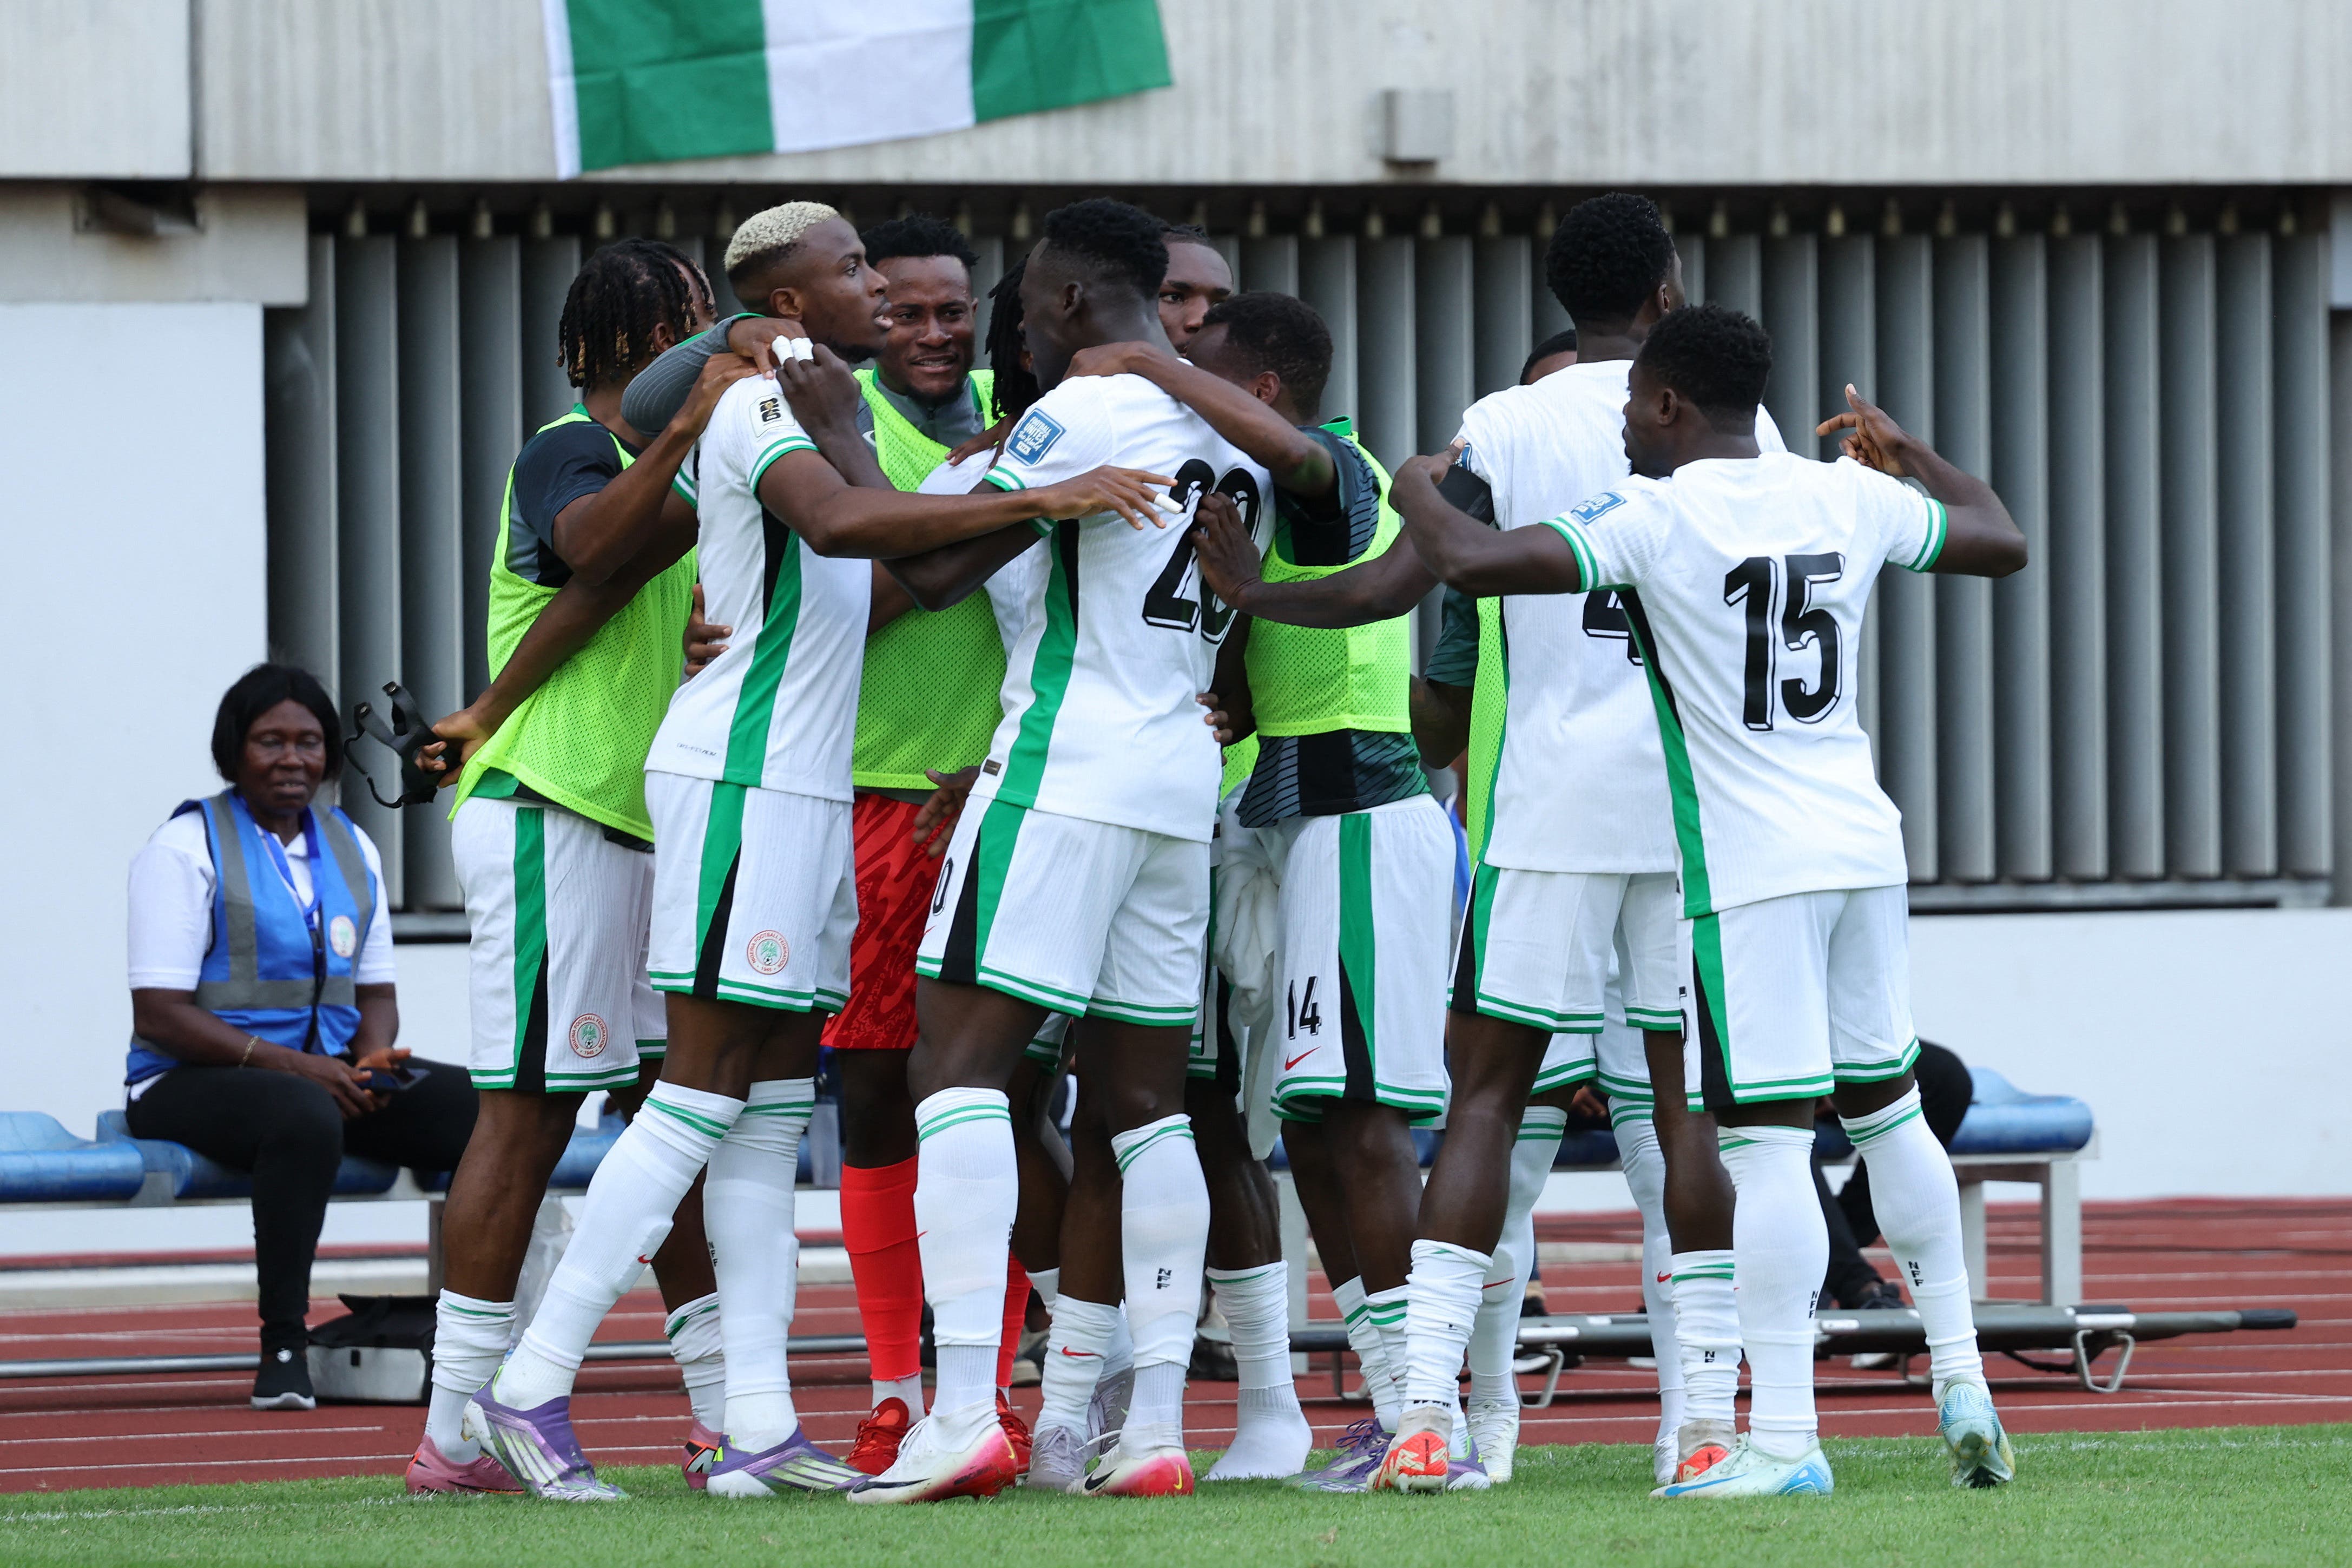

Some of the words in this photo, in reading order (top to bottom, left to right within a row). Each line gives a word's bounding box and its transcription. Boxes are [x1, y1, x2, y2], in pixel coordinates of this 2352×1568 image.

[1023, 422, 1048, 443] UNITES
[1724, 551, 1846, 732] 15
[1288, 976, 1322, 1040] 14
[1156, 1267, 1172, 1289] NFF
[1908, 1261, 1924, 1287] NFF
